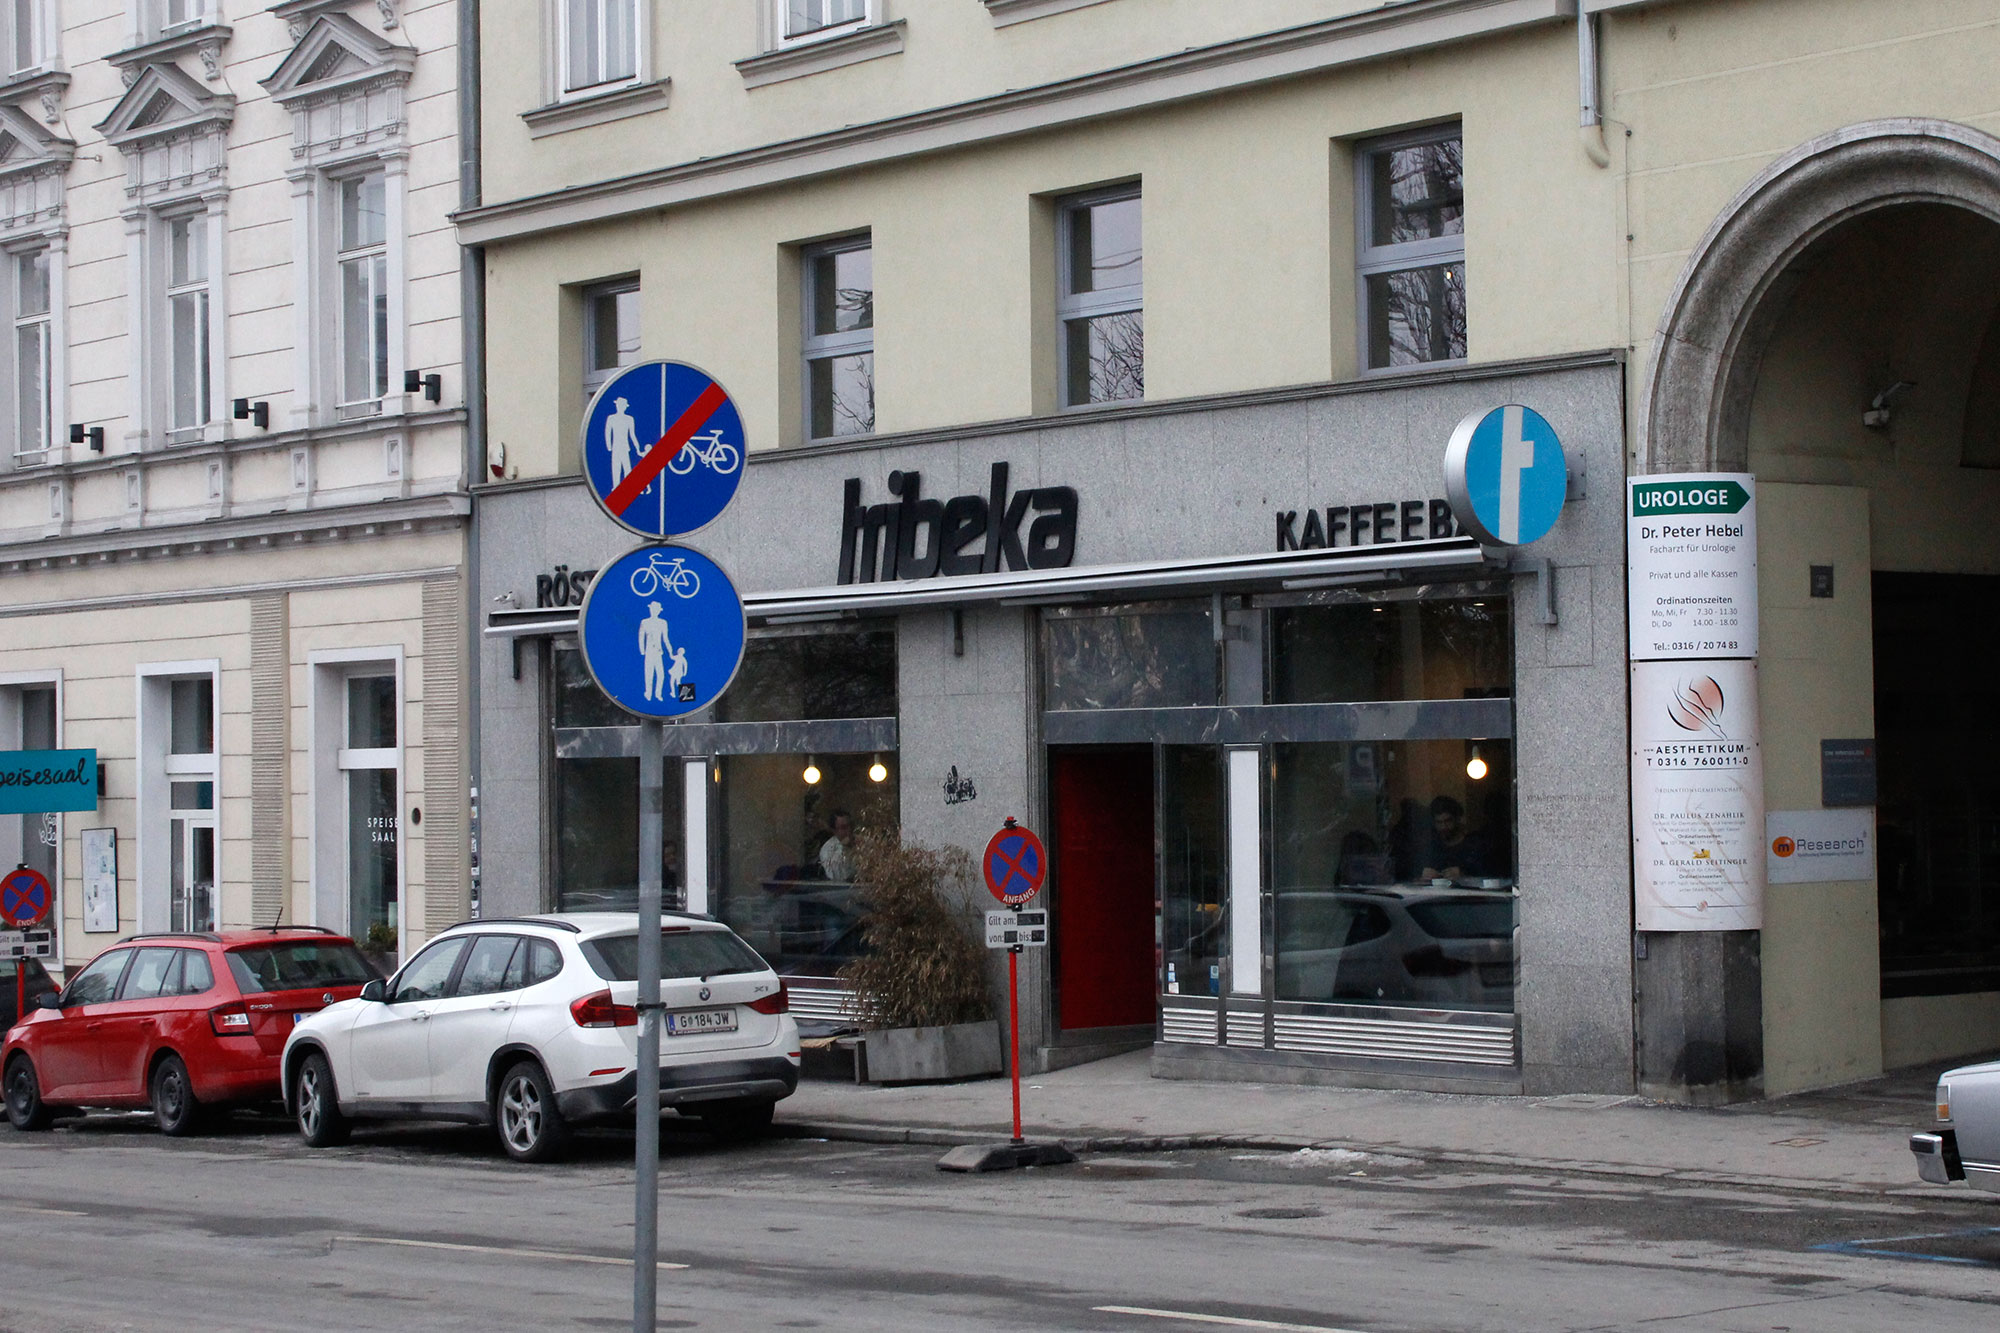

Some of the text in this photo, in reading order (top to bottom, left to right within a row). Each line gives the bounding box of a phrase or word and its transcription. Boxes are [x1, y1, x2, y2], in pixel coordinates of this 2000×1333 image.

[1639, 489, 1728, 508] UROLOGE
[837, 461, 1078, 585] tribeka
[1276, 499, 1471, 551] KAFFEEB
[1642, 524, 1743, 539] Dr. Peter Hebel
[1650, 544, 1736, 553] Facharzt für Urologie
[1649, 569, 1738, 579] Privat und alle Kassen
[1656, 595, 1733, 605] Ordinationszeiten
[1652, 609, 1665, 617] Mo,
[1666, 609, 1678, 617] Mi,
[1680, 608, 1687, 616] Fr
[1652, 620, 1661, 628] Di,
[1662, 620, 1672, 628] Do
[1653, 642, 1670, 651] Tel.:
[1672, 642, 1694, 650] 0316
[1696, 641, 1701, 650] /
[1716, 641, 1726, 649] 74
[1728, 641, 1738, 649] 83
[1647, 756, 1749, 766] T 0316 760011-0
[1670, 812, 1702, 820] PAULUS
[367, 817, 398, 828] SPEISE
[372, 832, 395, 842] SAAL
[1002, 887, 1035, 903] ANFANG
[16, 917, 37, 927] ENDE
[988, 915, 1017, 926] Gilt am:
[988, 930, 1033, 944] von: bis:
[753, 985, 769, 993] X1
[680, 1013, 729, 1027] G 184 JW
